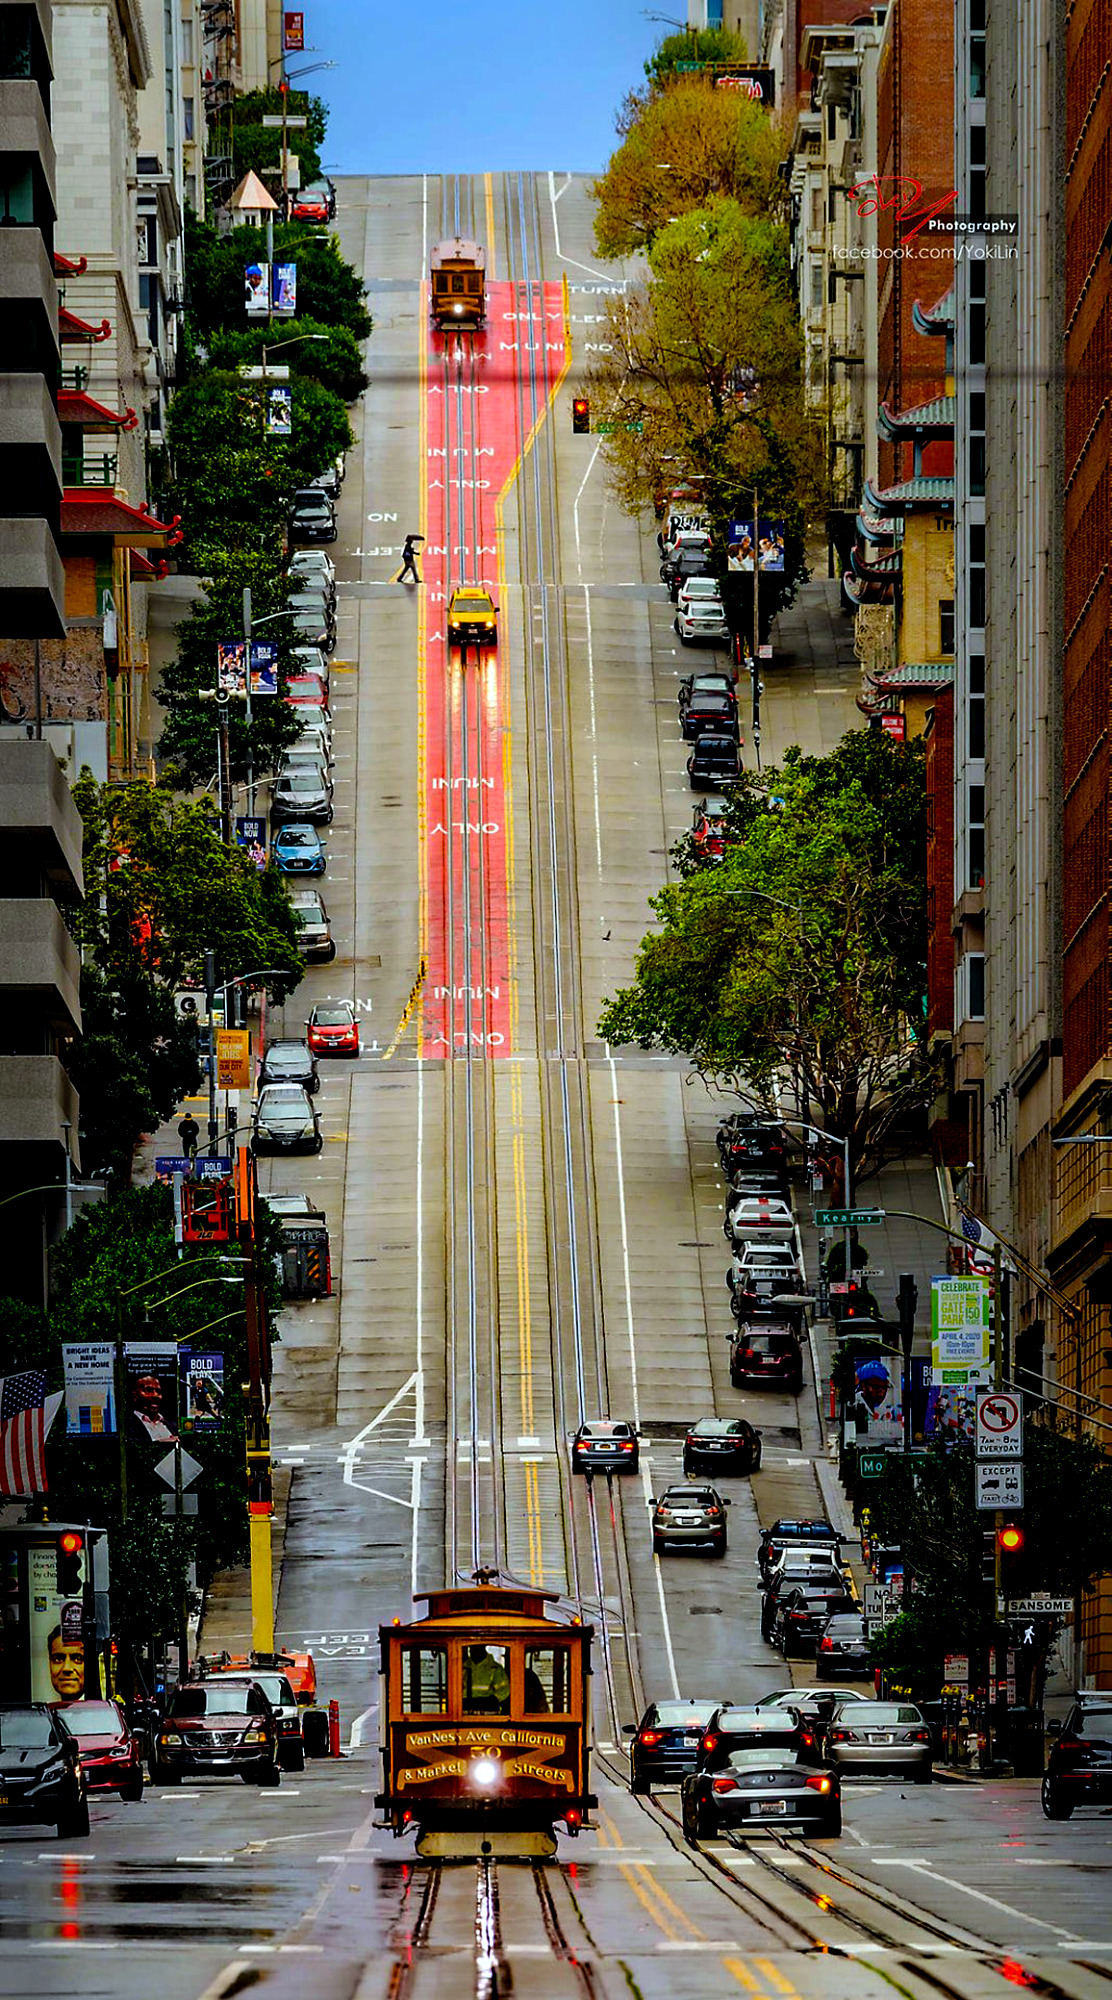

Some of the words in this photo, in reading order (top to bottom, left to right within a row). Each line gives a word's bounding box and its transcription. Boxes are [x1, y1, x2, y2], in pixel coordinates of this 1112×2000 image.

[569, 286, 624, 294] TURN
[503, 312, 560, 320] ONLY
[500, 342, 563, 351] MUNI
[584, 344, 613, 352] NO
[428, 385, 488, 393] ONLY
[428, 447, 494, 456] MUNI
[428, 480, 491, 488] ONLY
[368, 513, 398, 522] NO
[428, 546, 496, 555] MUNI
[432, 778, 494, 789] MUNI
[431, 823, 499, 834] ONLY
[434, 986, 499, 999] MUNI
[432, 1032, 504, 1046] ONLY
[204, 1162, 222, 1171] BOLD
[823, 1214, 872, 1223] Kearny
[941, 1282, 980, 1292] CELEBRATE
[941, 1302, 964, 1314] GATE
[966, 1306, 979, 1319] 150
[942, 1314, 964, 1325] PARK
[190, 1359, 213, 1370] BOLD
[980, 1445, 1019, 1453] EVERYDAY
[983, 1467, 1015, 1476] EXCEPT
[1010, 1601, 1071, 1611] SANSOME
[409, 1734, 431, 1745] Van
[466, 1731, 492, 1741] Ave
[501, 1731, 564, 1747] California
[404, 1770, 413, 1780] &
[417, 1762, 462, 1779] Market
[514, 1762, 566, 1781] Streets
